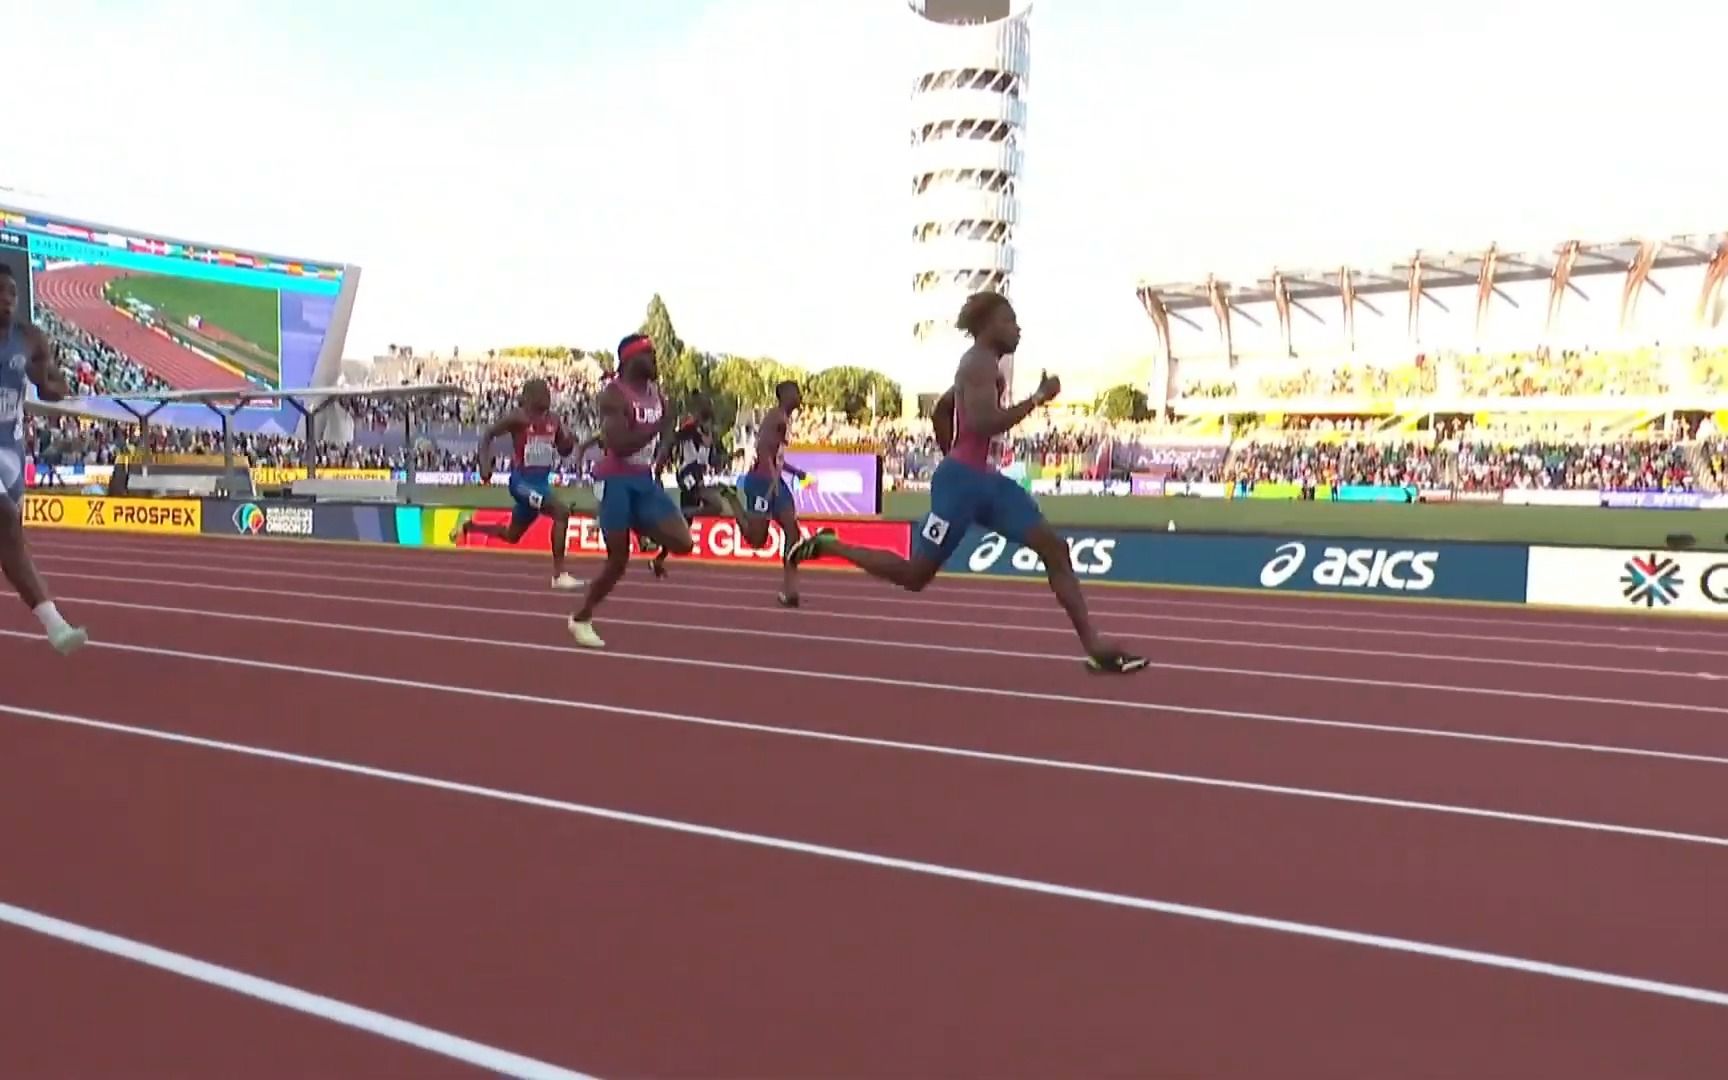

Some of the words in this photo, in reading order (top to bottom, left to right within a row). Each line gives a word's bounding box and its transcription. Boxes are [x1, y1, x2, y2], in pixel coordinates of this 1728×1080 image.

[24, 498, 64, 522] IKO
[113, 505, 196, 527] PROSPEX
[929, 521, 941, 538] 6
